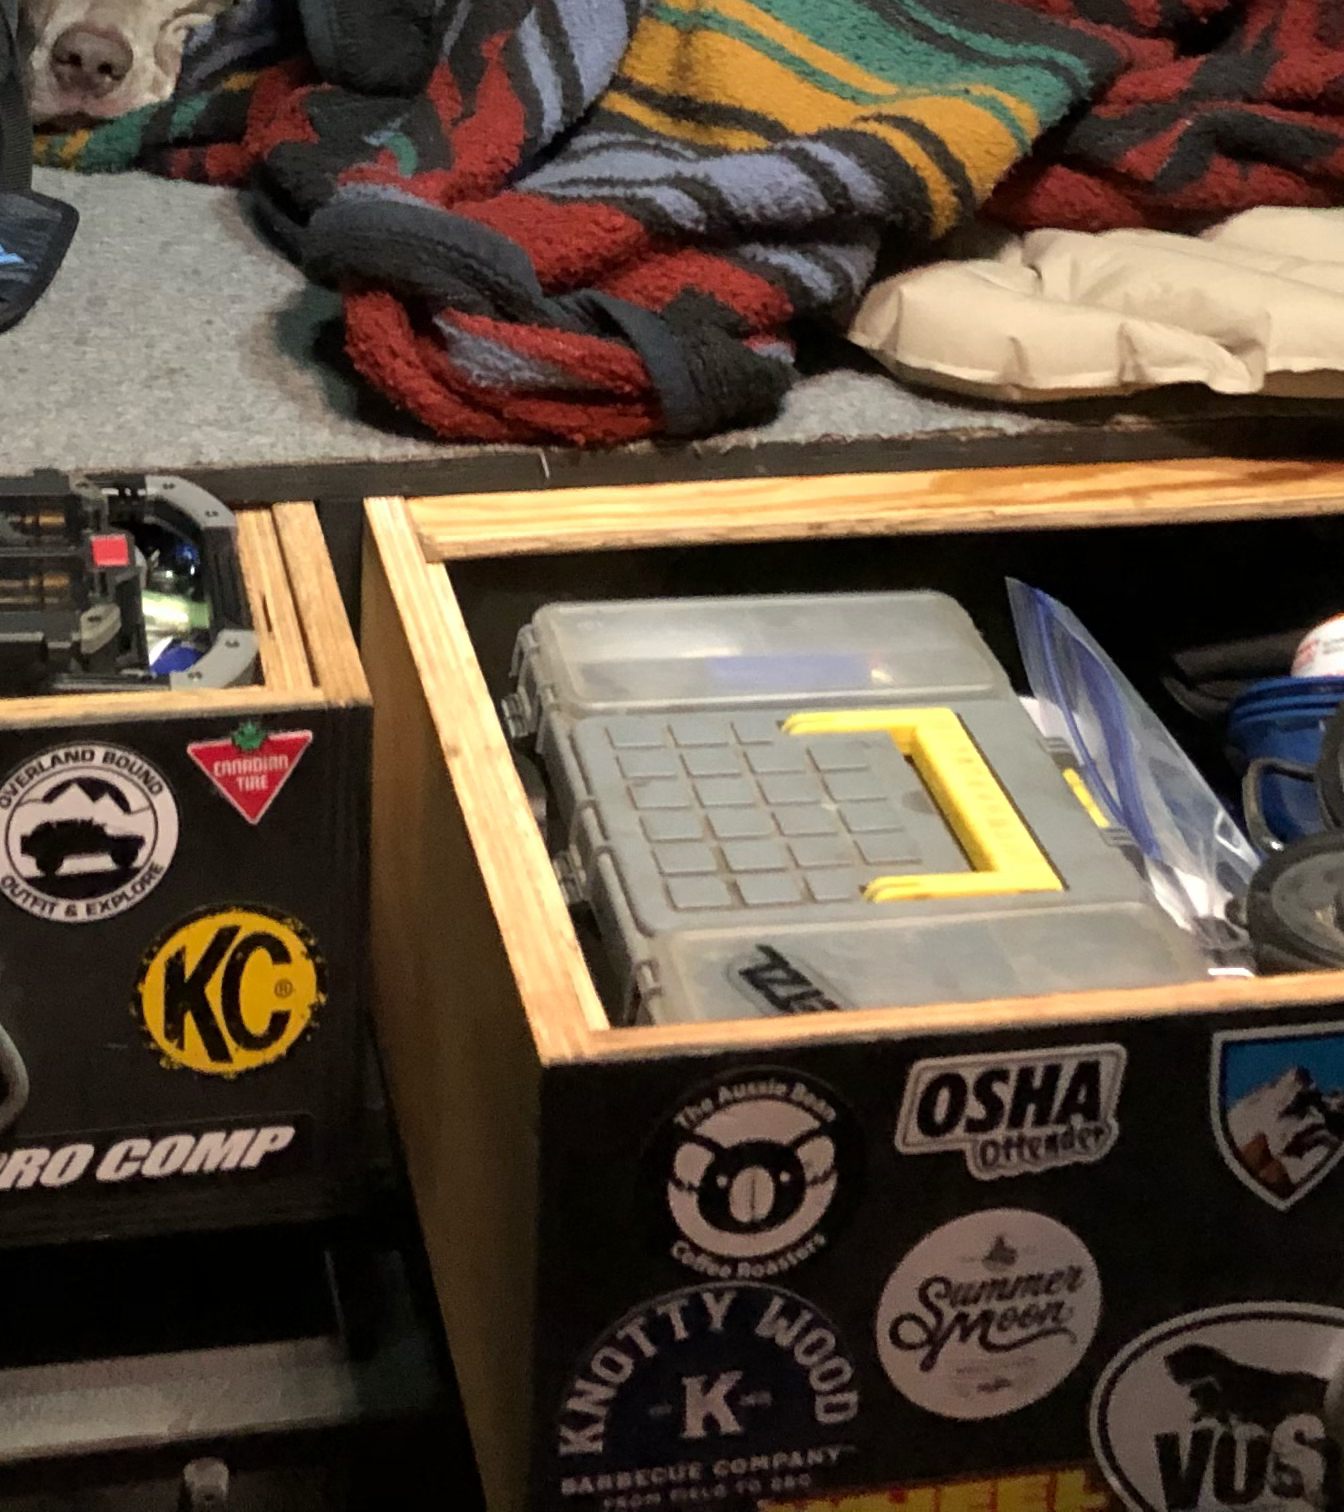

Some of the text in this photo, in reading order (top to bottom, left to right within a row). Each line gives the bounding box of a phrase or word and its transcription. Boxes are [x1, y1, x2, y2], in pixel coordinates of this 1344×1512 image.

[101, 750, 164, 796] BOUND
[236, 774, 269, 792] TIRE
[0, 861, 164, 917] OUTFIT & EXPLORE
[163, 925, 292, 1063] KC
[672, 1078, 837, 1130] The Aussie Bean
[916, 1061, 1101, 1138] OSHA
[94, 1124, 297, 1185] COMP
[670, 1232, 827, 1279] Coffee Roasters
[889, 1265, 1084, 1351] Summer
[919, 1301, 1078, 1373] Moon
[557, 1290, 860, 1458] KNOTTY WOOD
[560, 1447, 842, 1496] BARBECUE COMPANY
